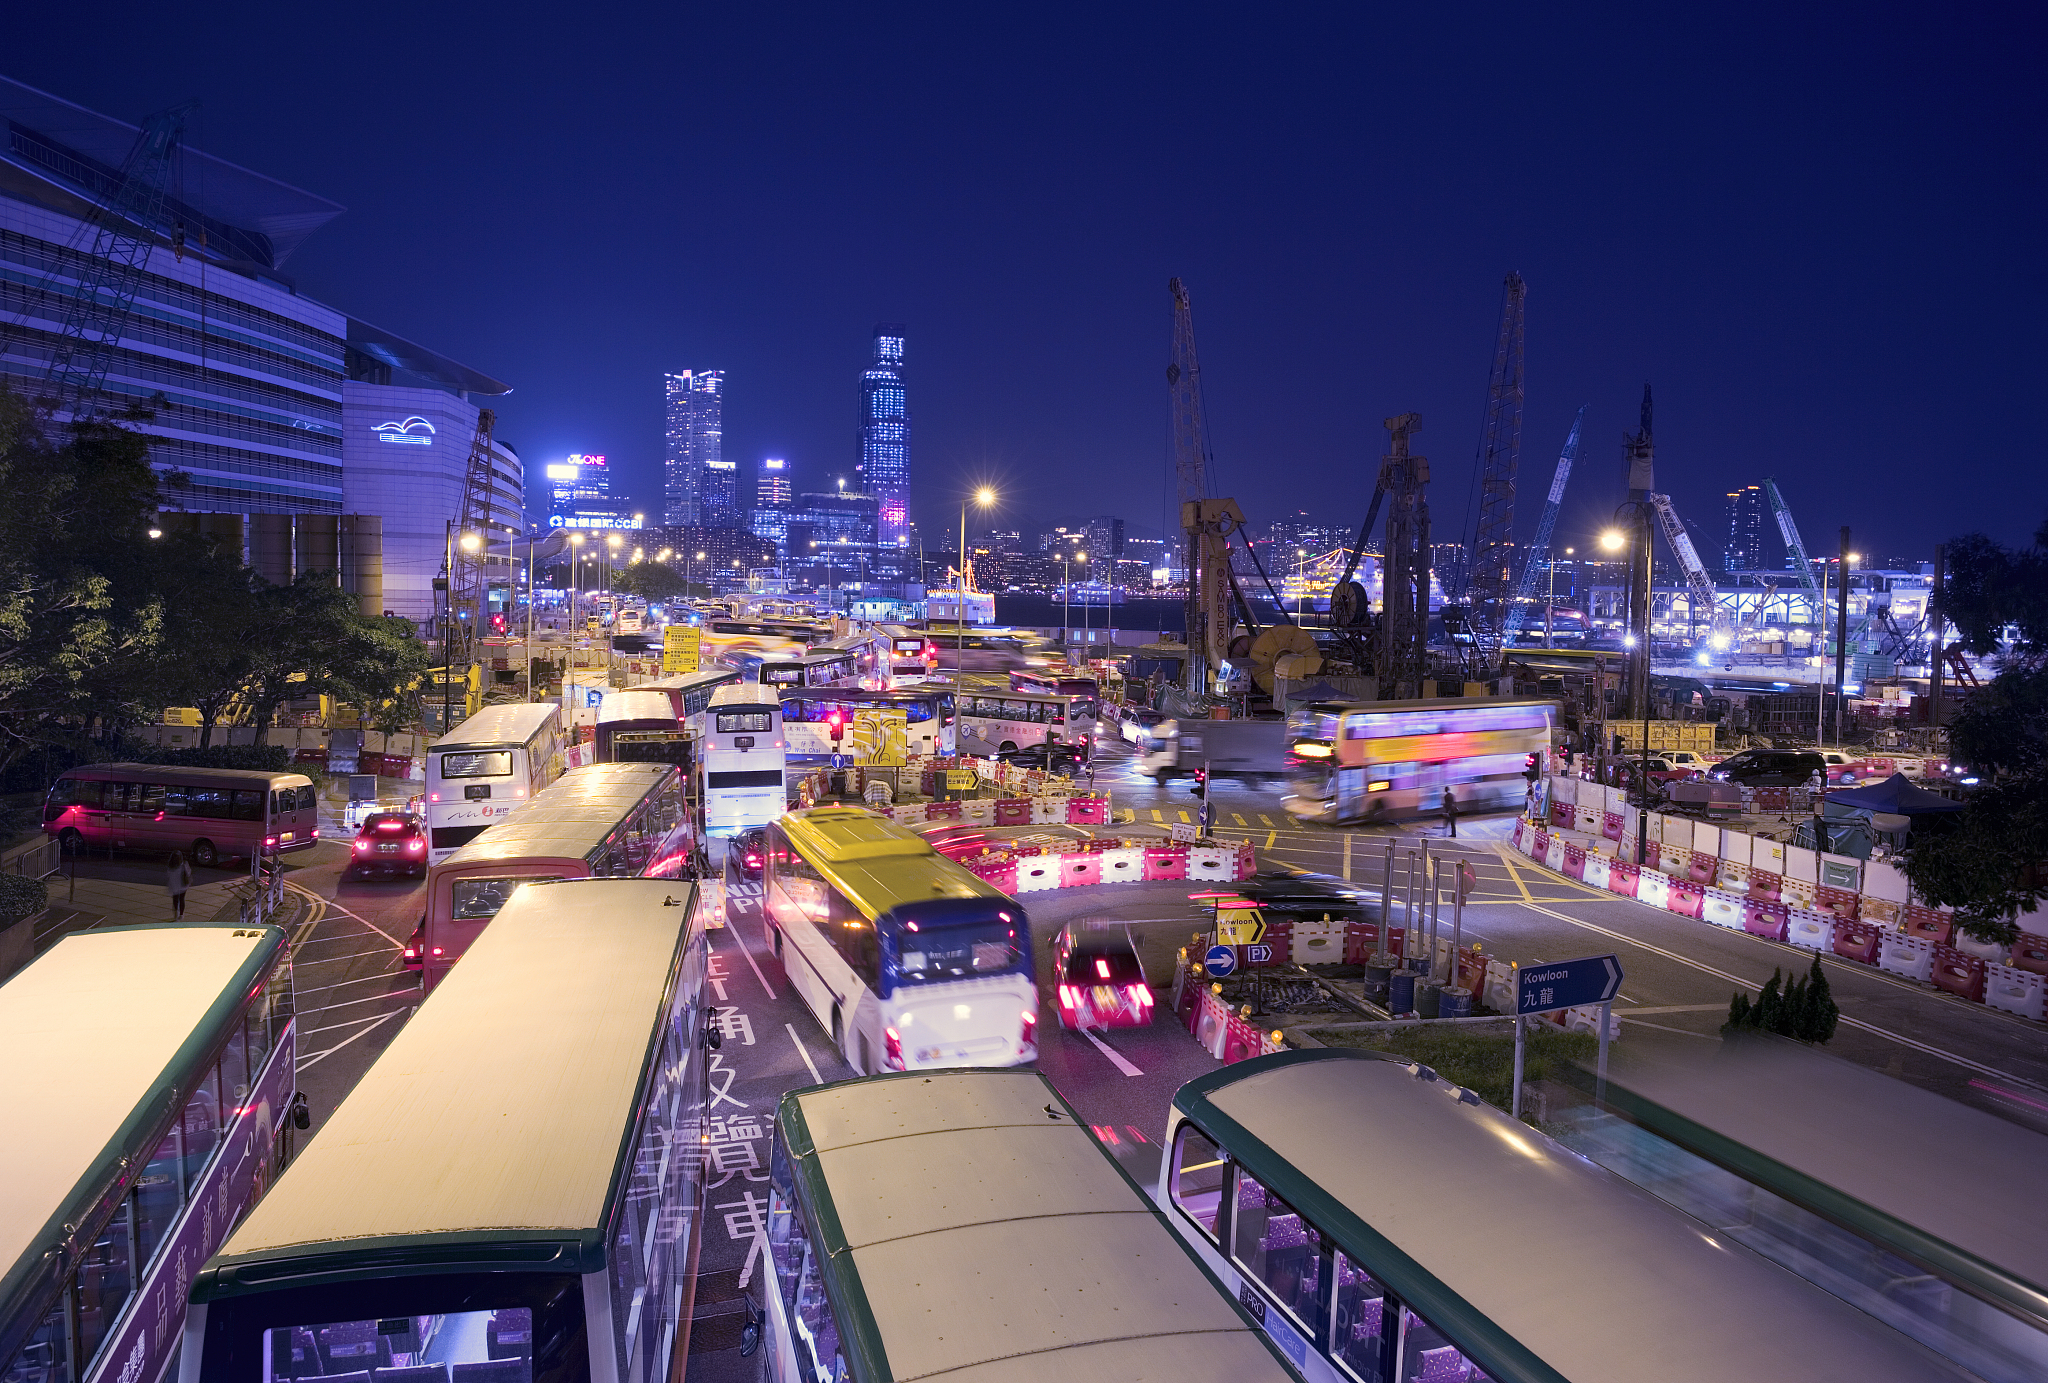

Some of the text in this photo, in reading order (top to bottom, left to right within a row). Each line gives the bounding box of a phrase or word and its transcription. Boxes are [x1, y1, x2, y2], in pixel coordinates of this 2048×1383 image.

[567, 454, 606, 466] The ONE
[614, 519, 642, 530] CCBI
[1217, 580, 1225, 619] SAMBO
[1217, 621, 1225, 648] E&C
[1220, 926, 1237, 936] 九龍
[1252, 948, 1260, 960] P
[1524, 970, 1568, 985] Kowloon
[1523, 987, 1554, 1008] 九龍
[1246, 1291, 1264, 1317] PRO
[1266, 1311, 1301, 1355] HairCare
